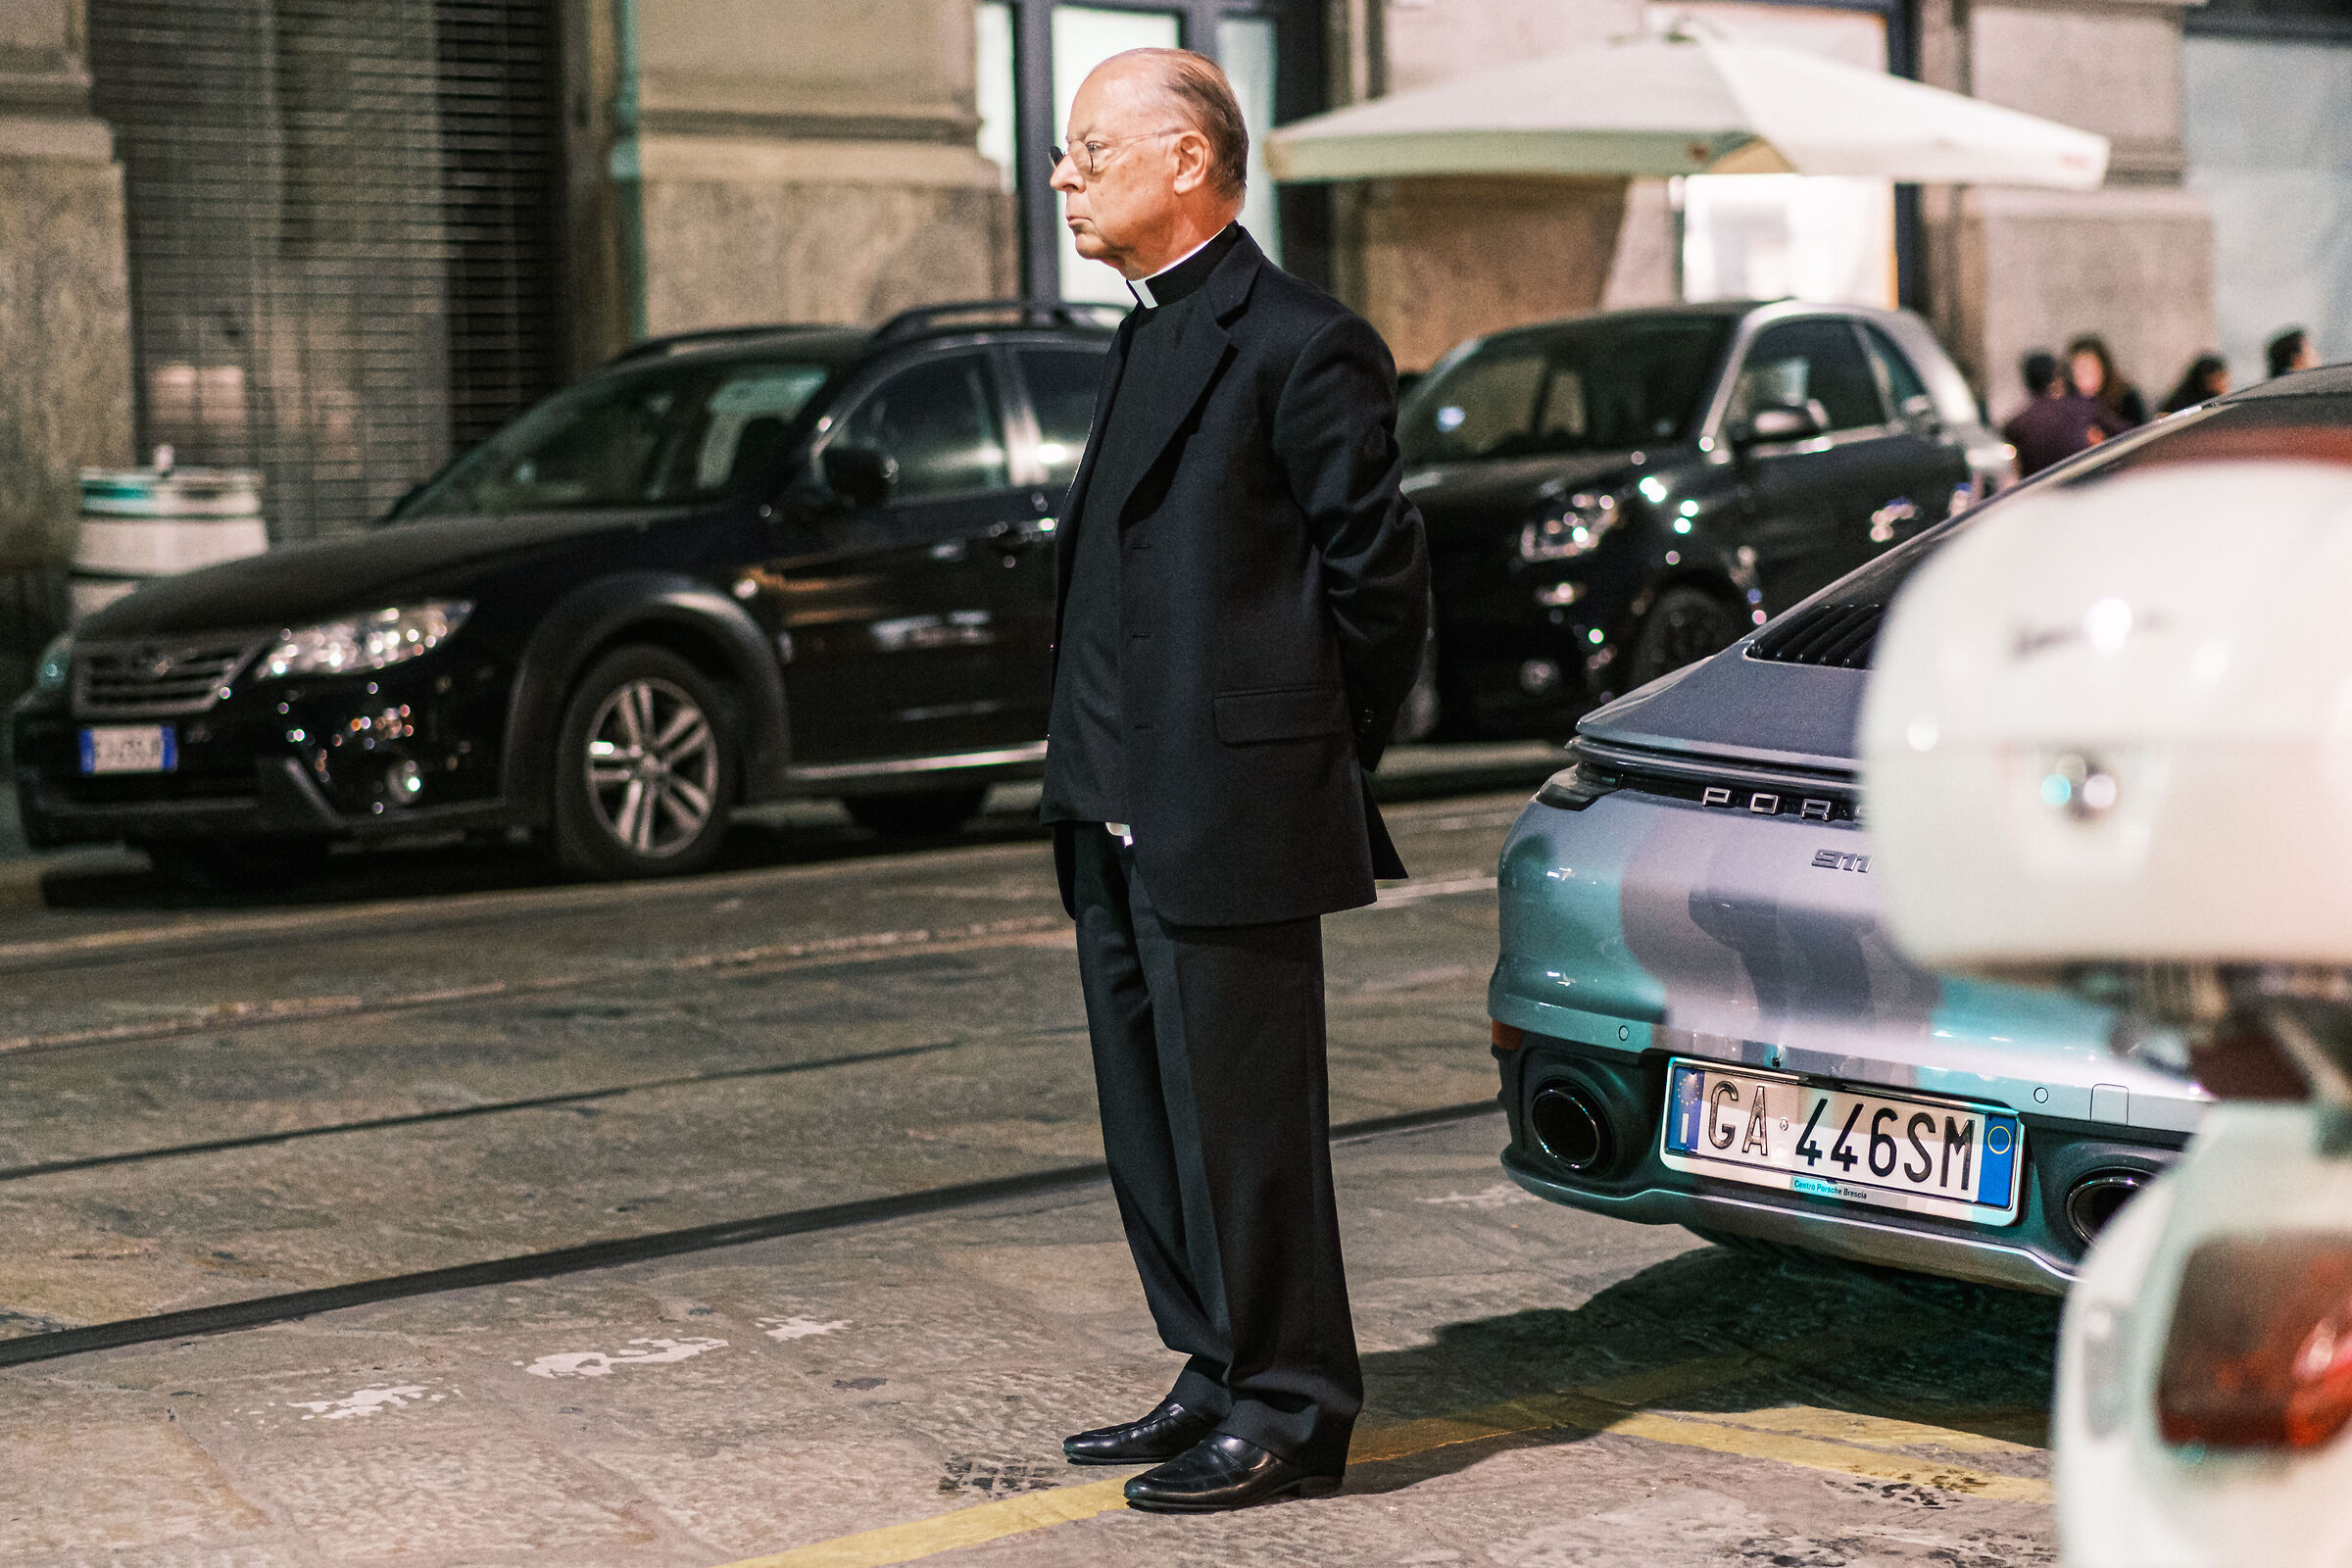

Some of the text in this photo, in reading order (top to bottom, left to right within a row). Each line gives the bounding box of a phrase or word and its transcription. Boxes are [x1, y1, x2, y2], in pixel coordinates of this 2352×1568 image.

[1812, 849, 1873, 873] 911
[1708, 1081, 1976, 1191] GA 446SM
[1793, 1179, 1868, 1200] Centro Porsche Brescia
